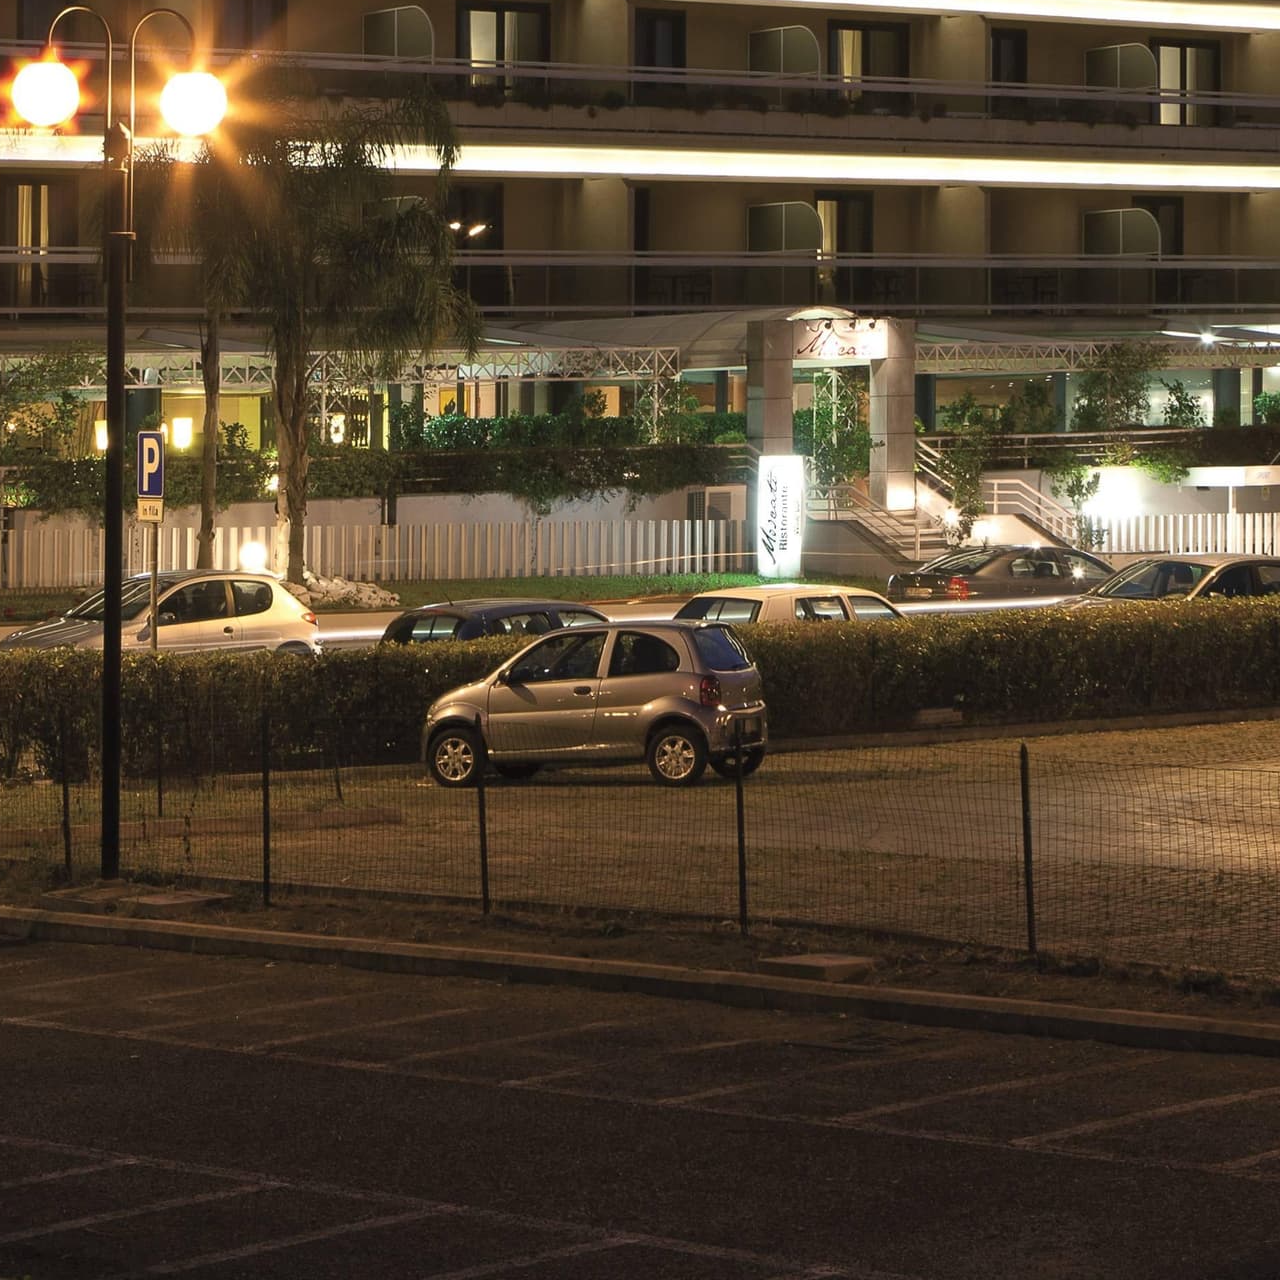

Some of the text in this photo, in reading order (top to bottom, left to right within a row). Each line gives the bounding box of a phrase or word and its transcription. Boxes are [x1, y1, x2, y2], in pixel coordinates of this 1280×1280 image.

[143, 438, 160, 491] P
[760, 471, 778, 565] Moscati
[778, 485, 788, 551] Ristorante
